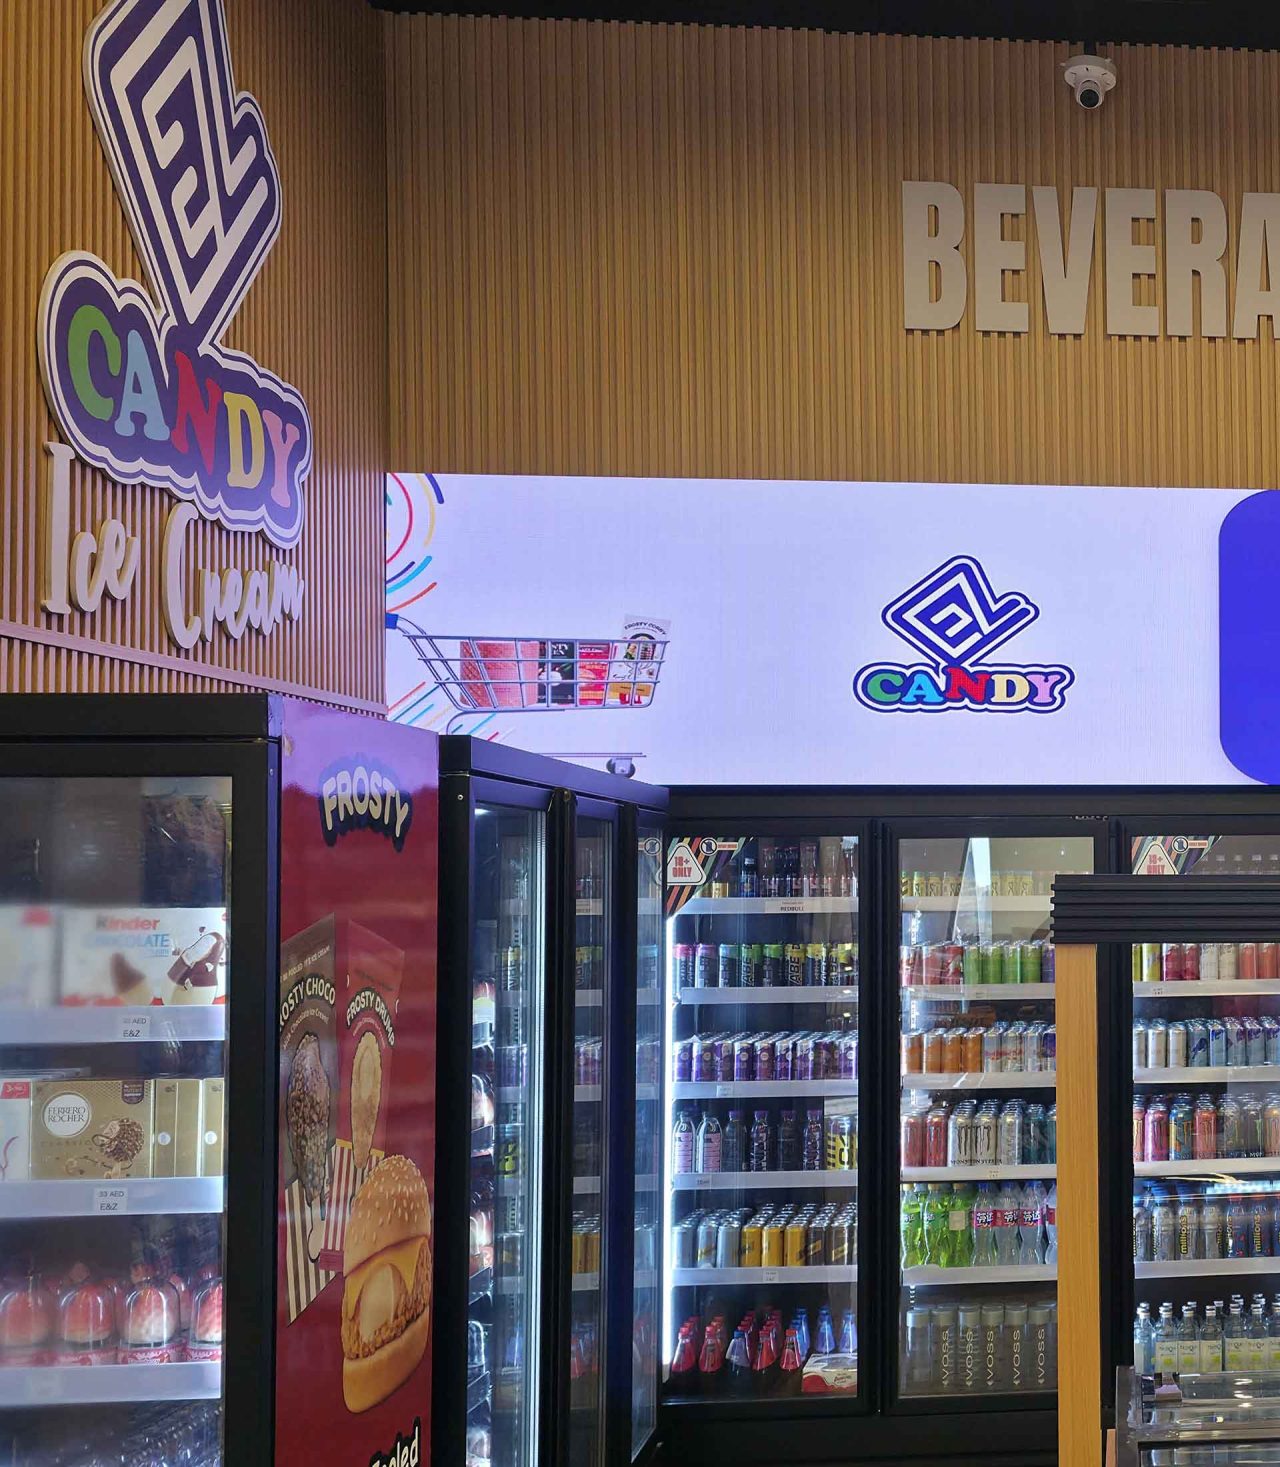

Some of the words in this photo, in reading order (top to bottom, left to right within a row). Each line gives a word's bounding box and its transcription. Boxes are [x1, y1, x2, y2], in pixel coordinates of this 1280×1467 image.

[67, 304, 300, 508] CANDY
[41, 441, 139, 615] Ice
[162, 501, 304, 649] Cream
[867, 666, 1061, 703] CANDY
[323, 766, 409, 838] FROSTY
[672, 867, 692, 877] ONLY
[674, 856, 690, 866] 18+
[306, 977, 336, 1006] CHOCO
[347, 991, 375, 1026] FROSTY
[123, 1030, 140, 1038] E&Z
[48, 1106, 86, 1115] FERRERO
[48, 1115, 86, 1123] ROCHER
[100, 1203, 118, 1211] E&Z
[1179, 1215, 1187, 1254] millions
[1253, 1214, 1261, 1253] millions
